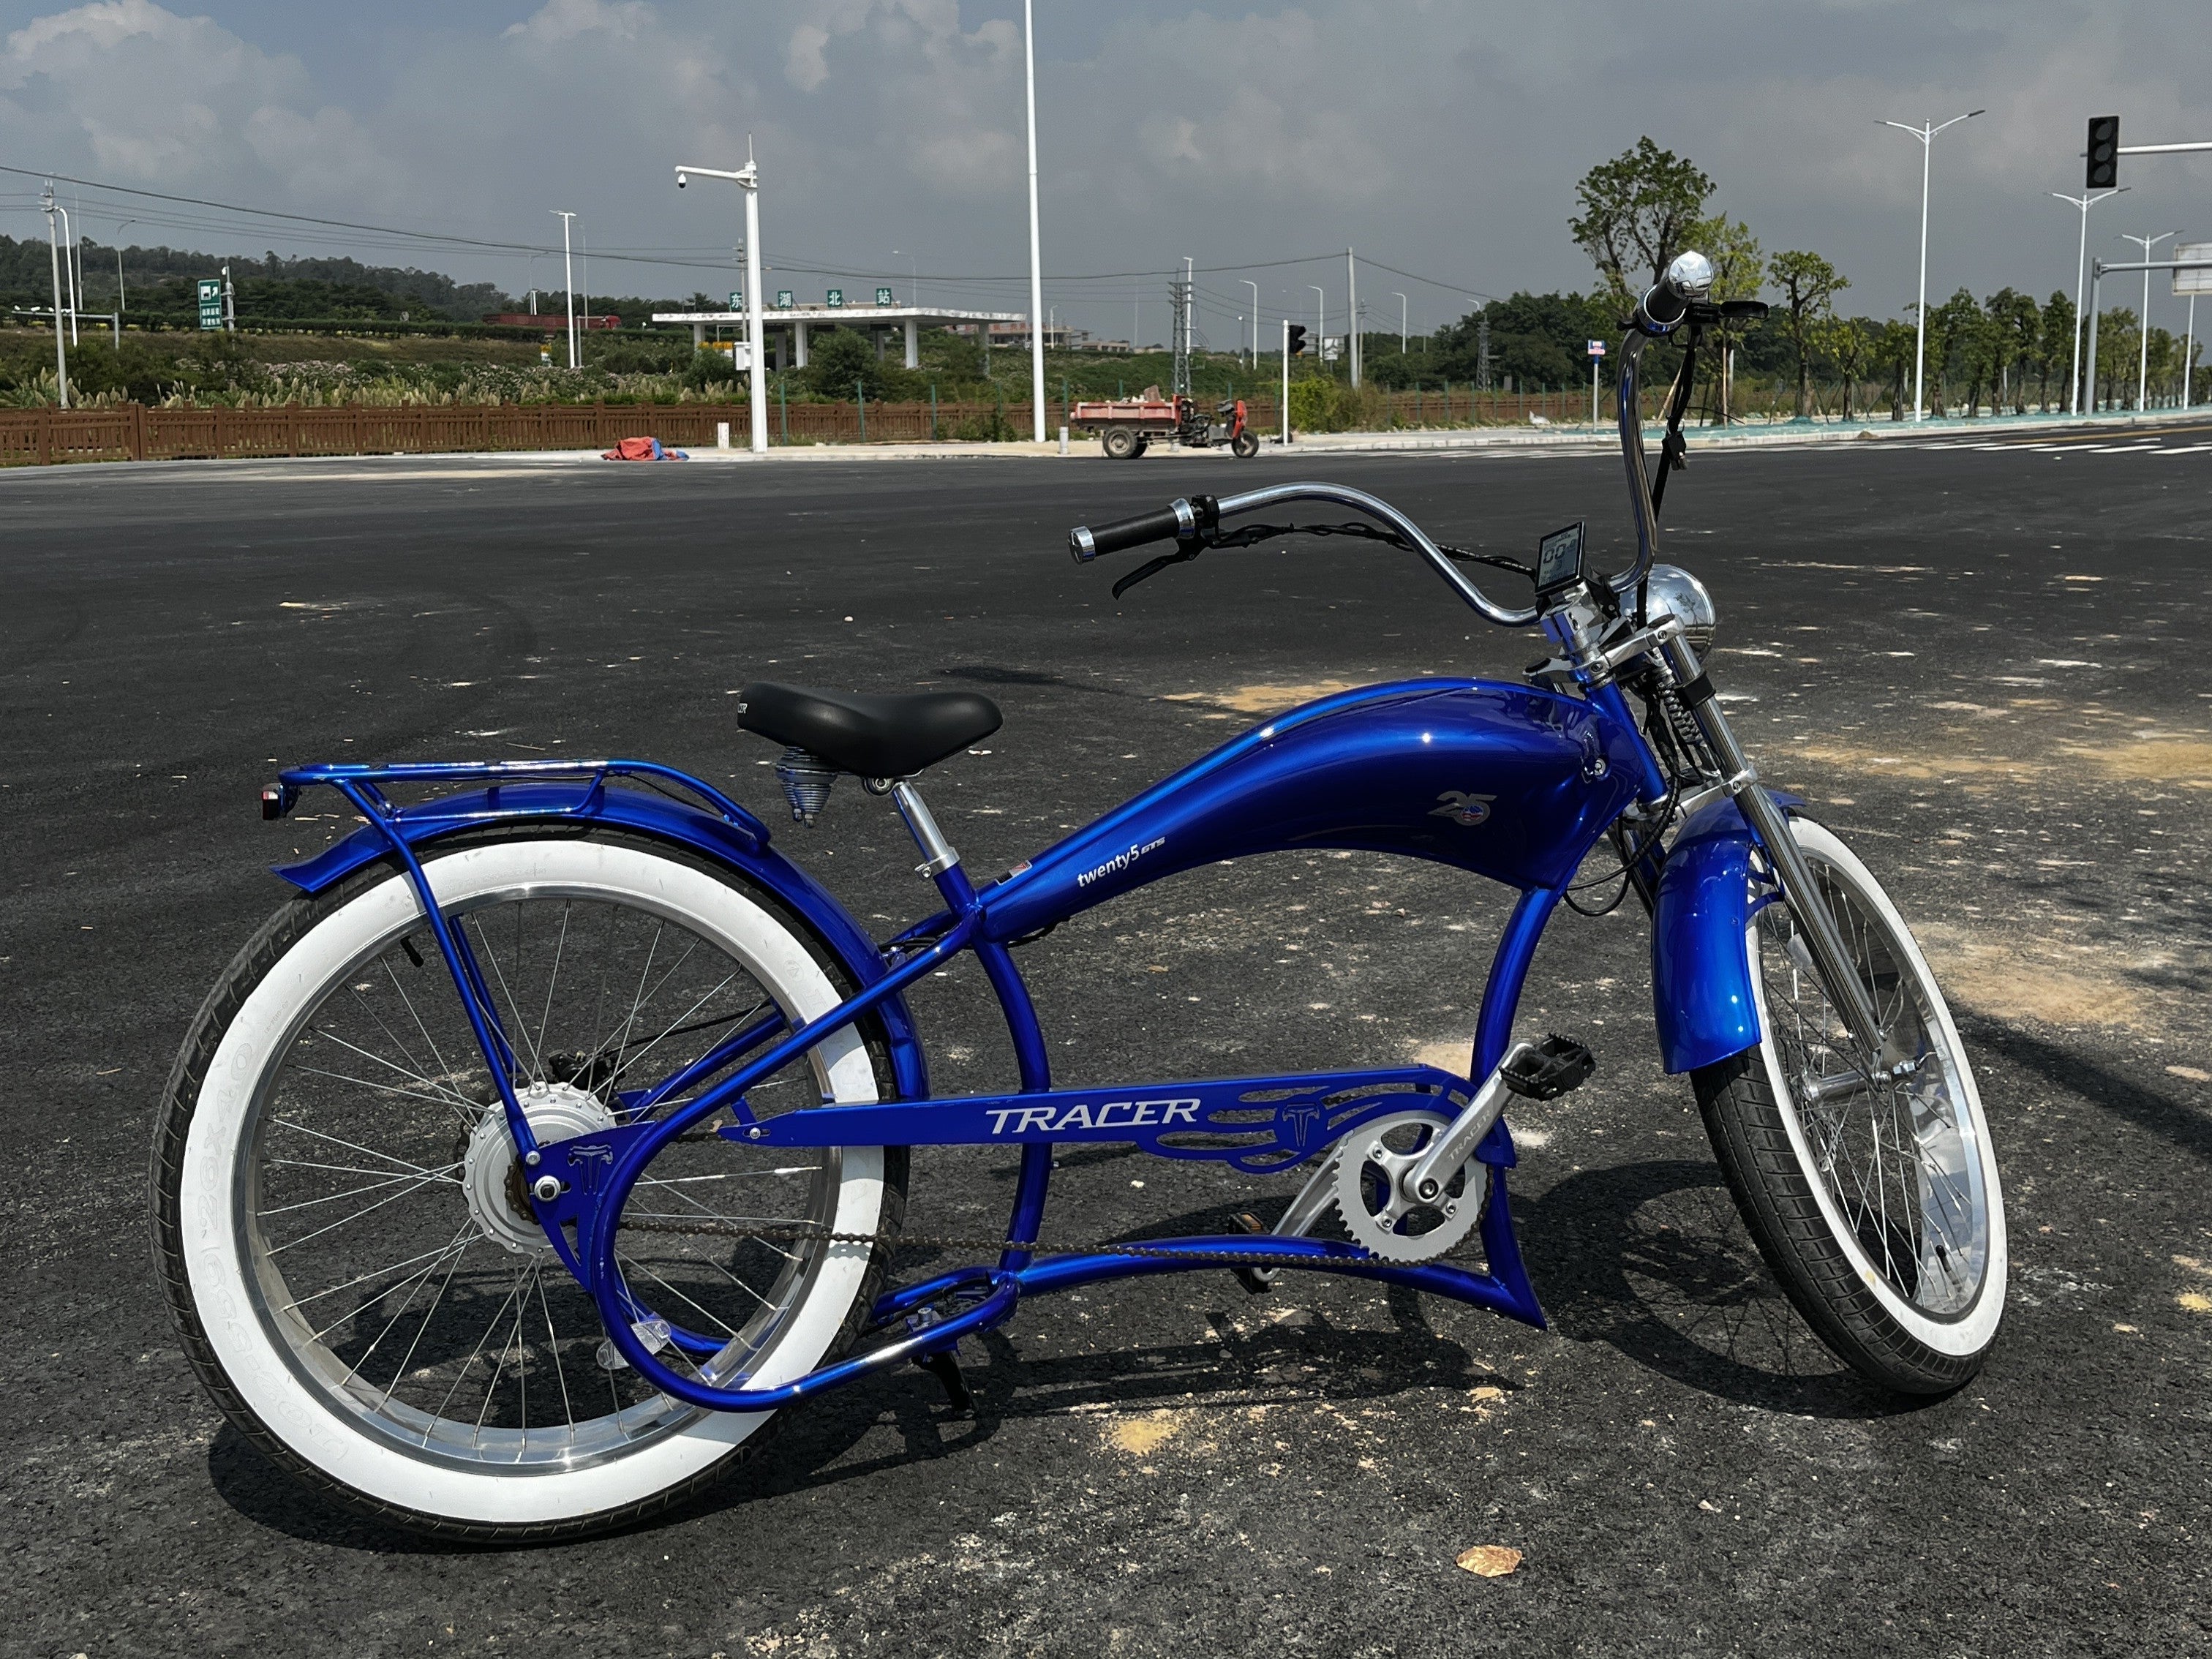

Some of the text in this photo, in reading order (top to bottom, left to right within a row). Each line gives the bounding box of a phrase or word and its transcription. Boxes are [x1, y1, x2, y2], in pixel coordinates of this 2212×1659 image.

[731, 289, 891, 308] 东湖北站
[1427, 791, 1497, 826] 25
[1077, 836, 1166, 887] twenty5 GTS
[985, 1098, 1200, 1134] TRACER
[1448, 1110, 1491, 1161] TRACER
